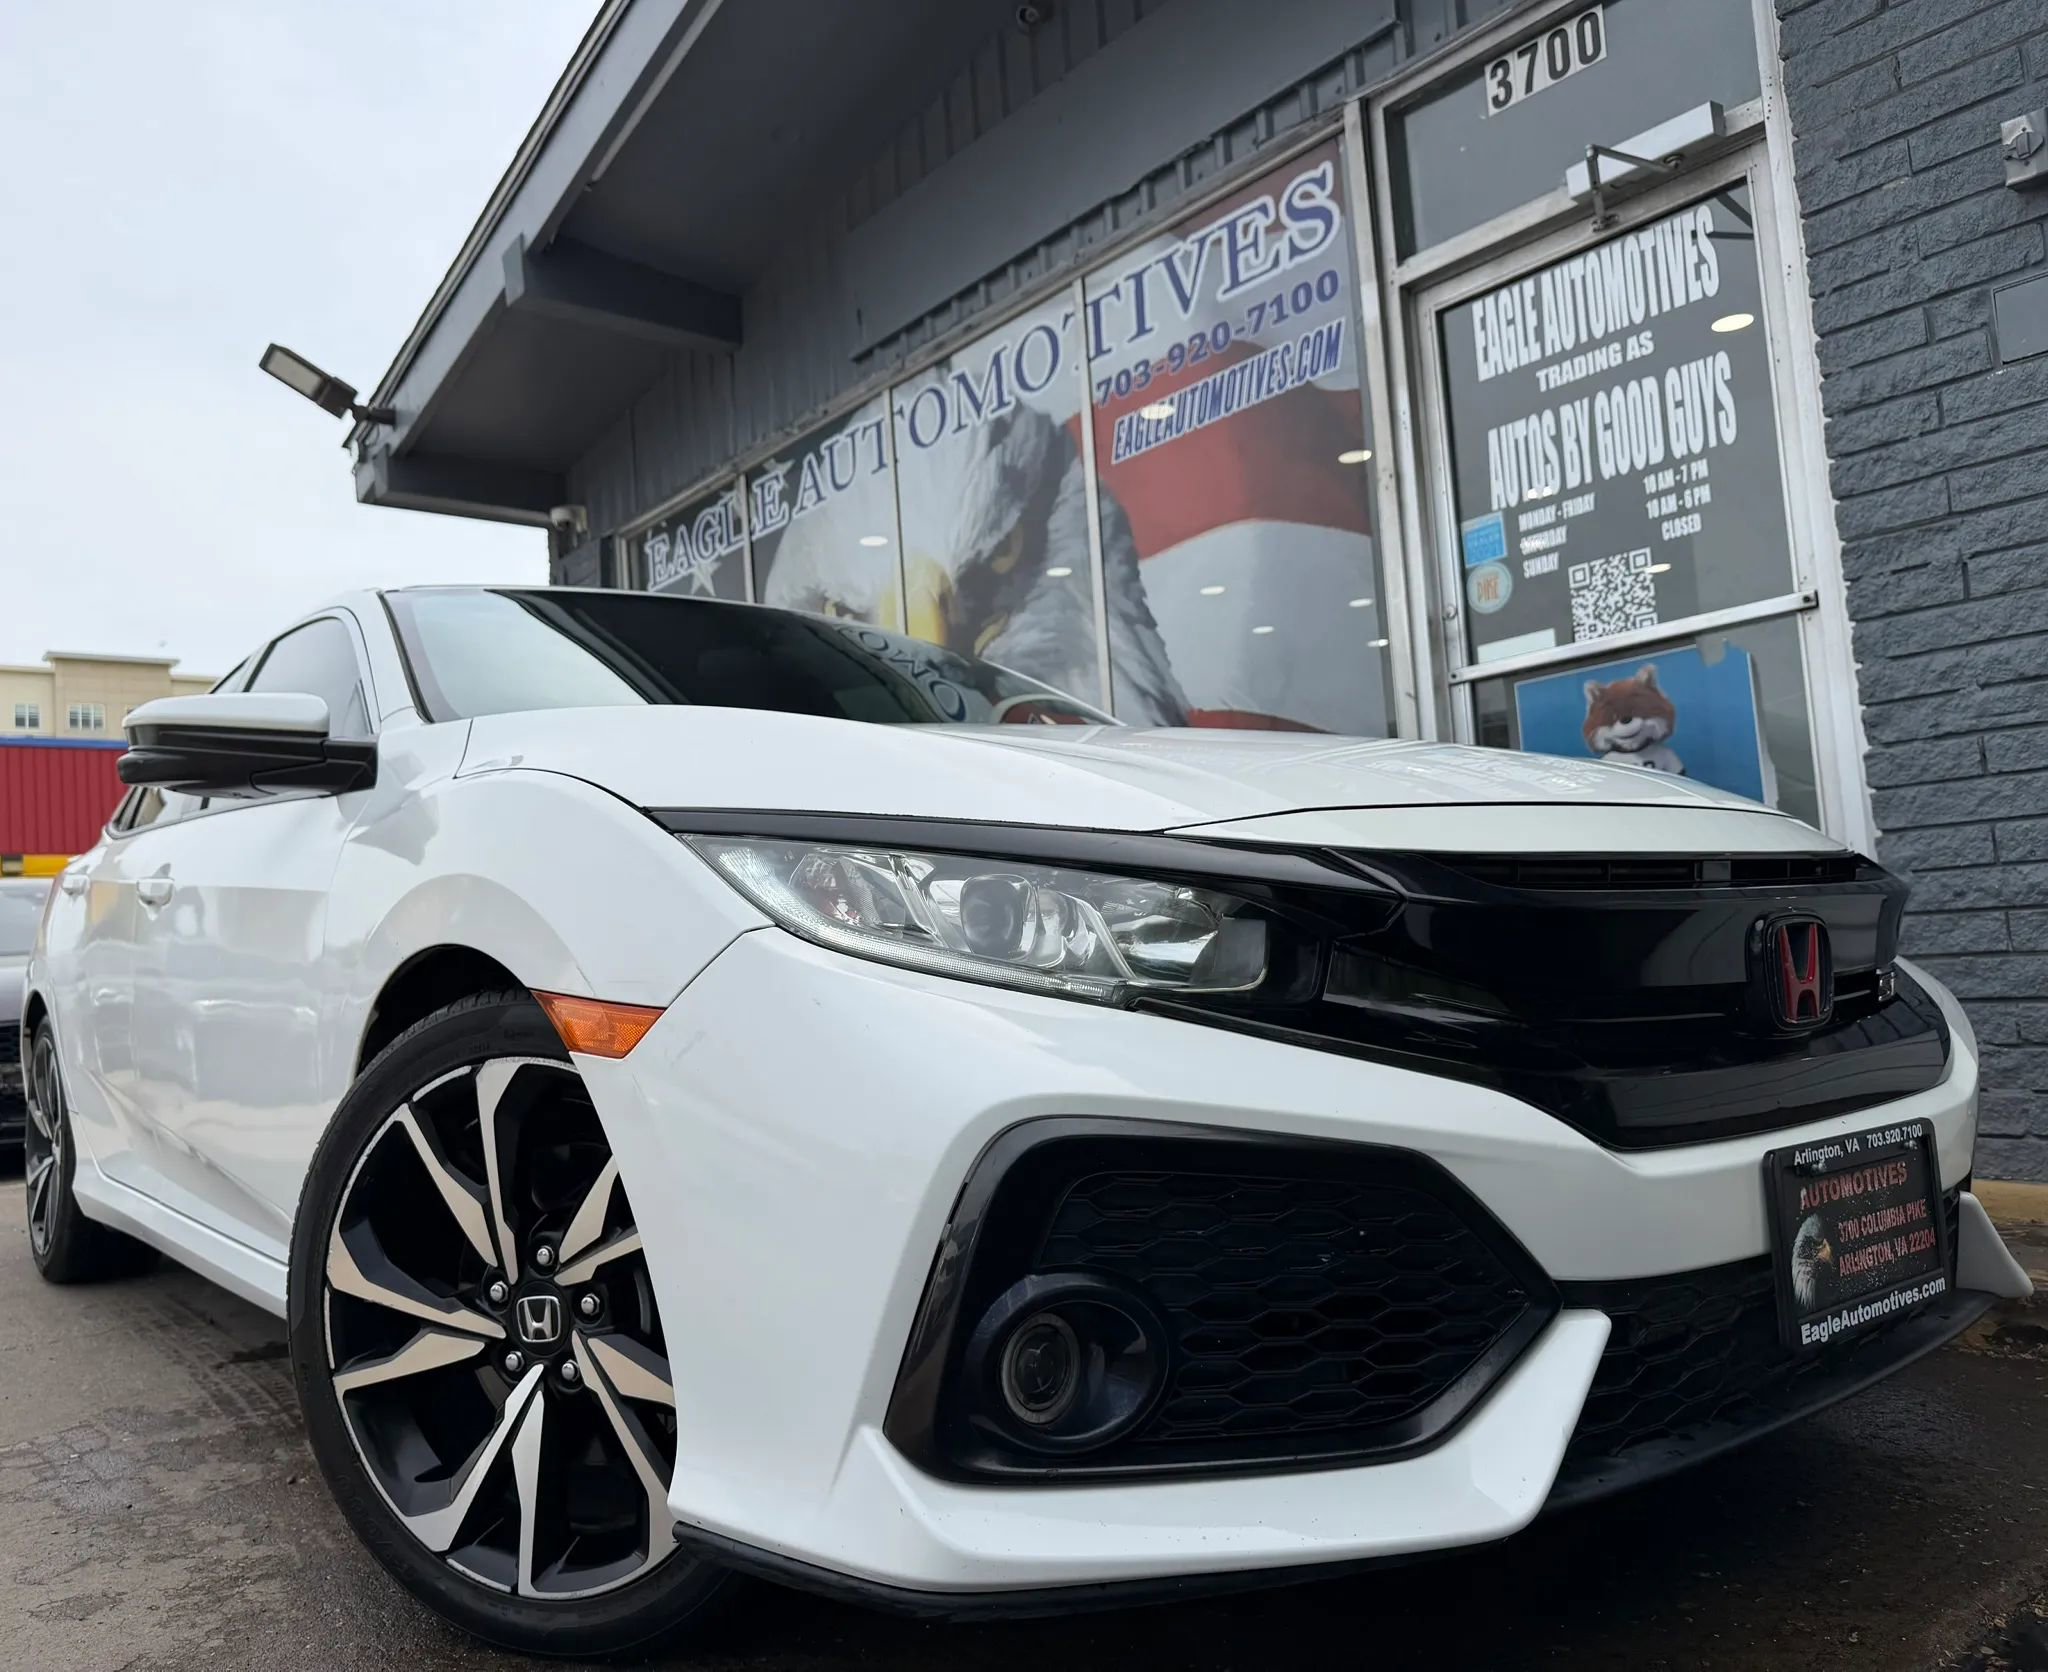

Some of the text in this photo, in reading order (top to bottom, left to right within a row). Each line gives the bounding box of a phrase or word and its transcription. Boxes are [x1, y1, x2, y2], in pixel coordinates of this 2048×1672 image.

[1490, 12, 1601, 109] 3700
[1472, 205, 1719, 382] EAGLE AUTOMOTIVES
[1096, 269, 1340, 408] 703-920-7100
[1536, 331, 1655, 392] TRADING AS
[644, 160, 1342, 592] EAGLE AUTOMOTIVES
[1111, 317, 1345, 464] EAGLEAUTOMOTIVES.COM
[1488, 351, 1738, 512] AUTOS BY GOOD GUYS
[1643, 474, 1657, 495] 10
[1657, 468, 1675, 491] AM
[1690, 458, 1709, 481] PM
[1646, 499, 1660, 519] 10
[1660, 493, 1678, 516] AM
[1693, 483, 1712, 507] PM
[1518, 503, 1557, 532] MONDAY
[1562, 492, 1596, 520] FRIDAY
[1661, 513, 1702, 541] CLOSED
[1522, 551, 1560, 579] SUNDAY
[1794, 1123, 1923, 1166] Arlington, VA 703.920.7100
[1801, 1161, 1908, 1210] AUTOMOTIVES
[1860, 1205, 1906, 1237] COLUMBIA
[1905, 1198, 1927, 1223] PIKE
[1839, 1227, 1936, 1277] ARLINGTON, VA 22204
[1801, 1276, 1946, 1345] EagleAutomotives.com
